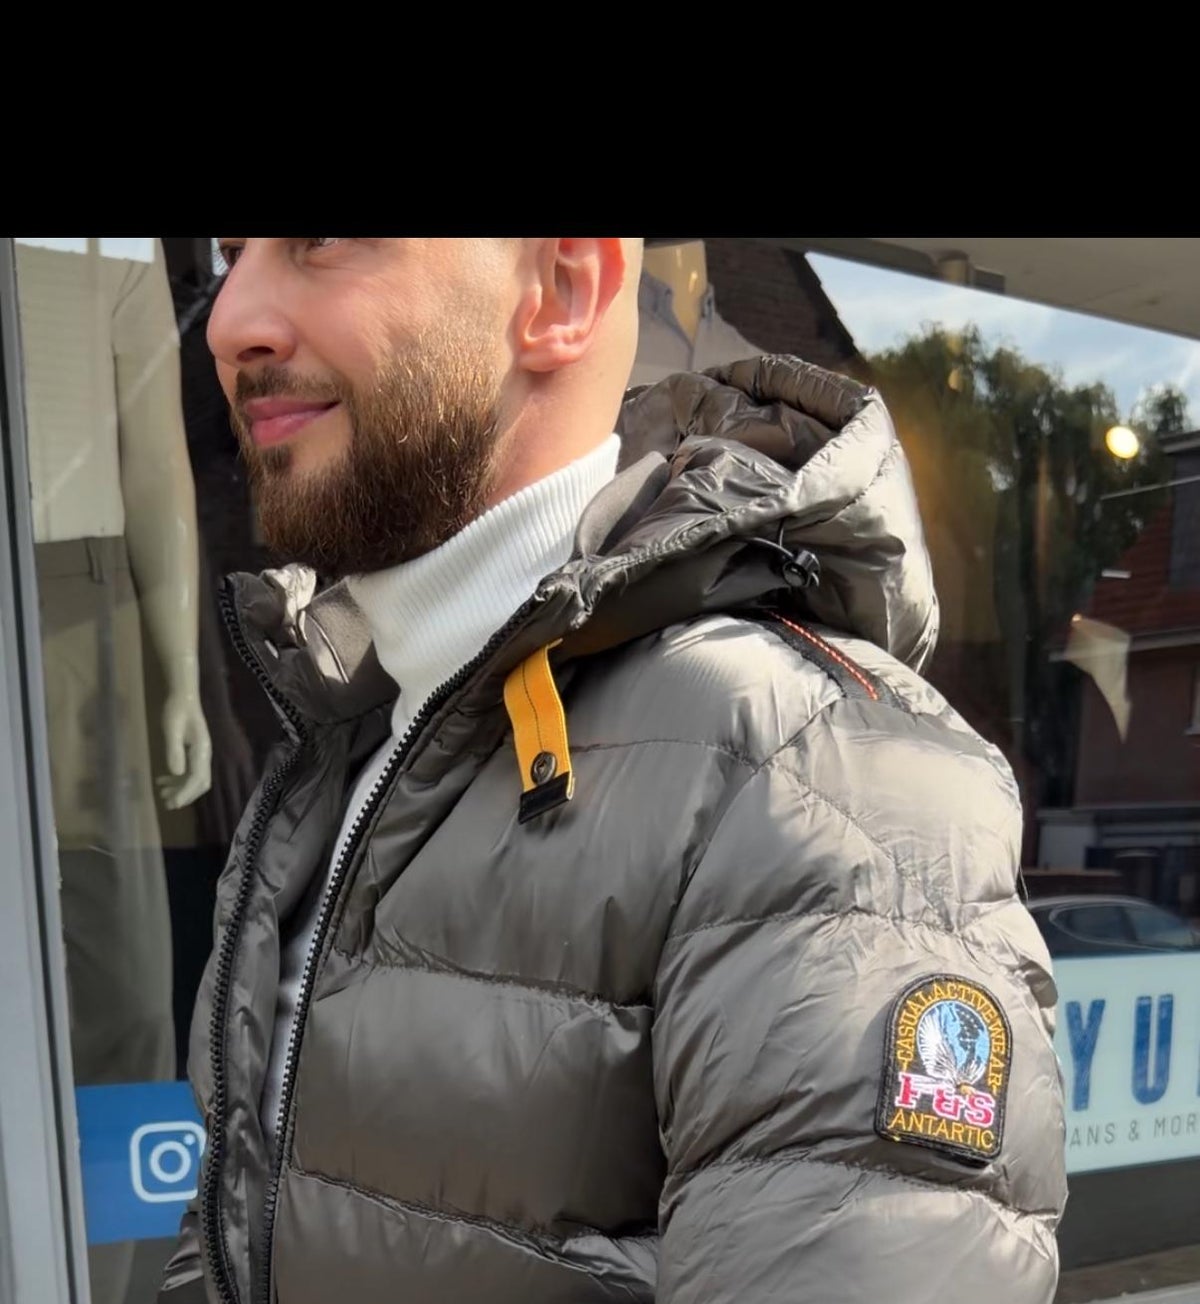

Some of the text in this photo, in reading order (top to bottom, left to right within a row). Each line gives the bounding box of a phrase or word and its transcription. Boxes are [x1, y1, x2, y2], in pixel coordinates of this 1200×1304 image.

[1065, 993, 1200, 1112] YU
[887, 1108, 995, 1149] ANTARTIC
[1127, 1119, 1139, 1142] &
